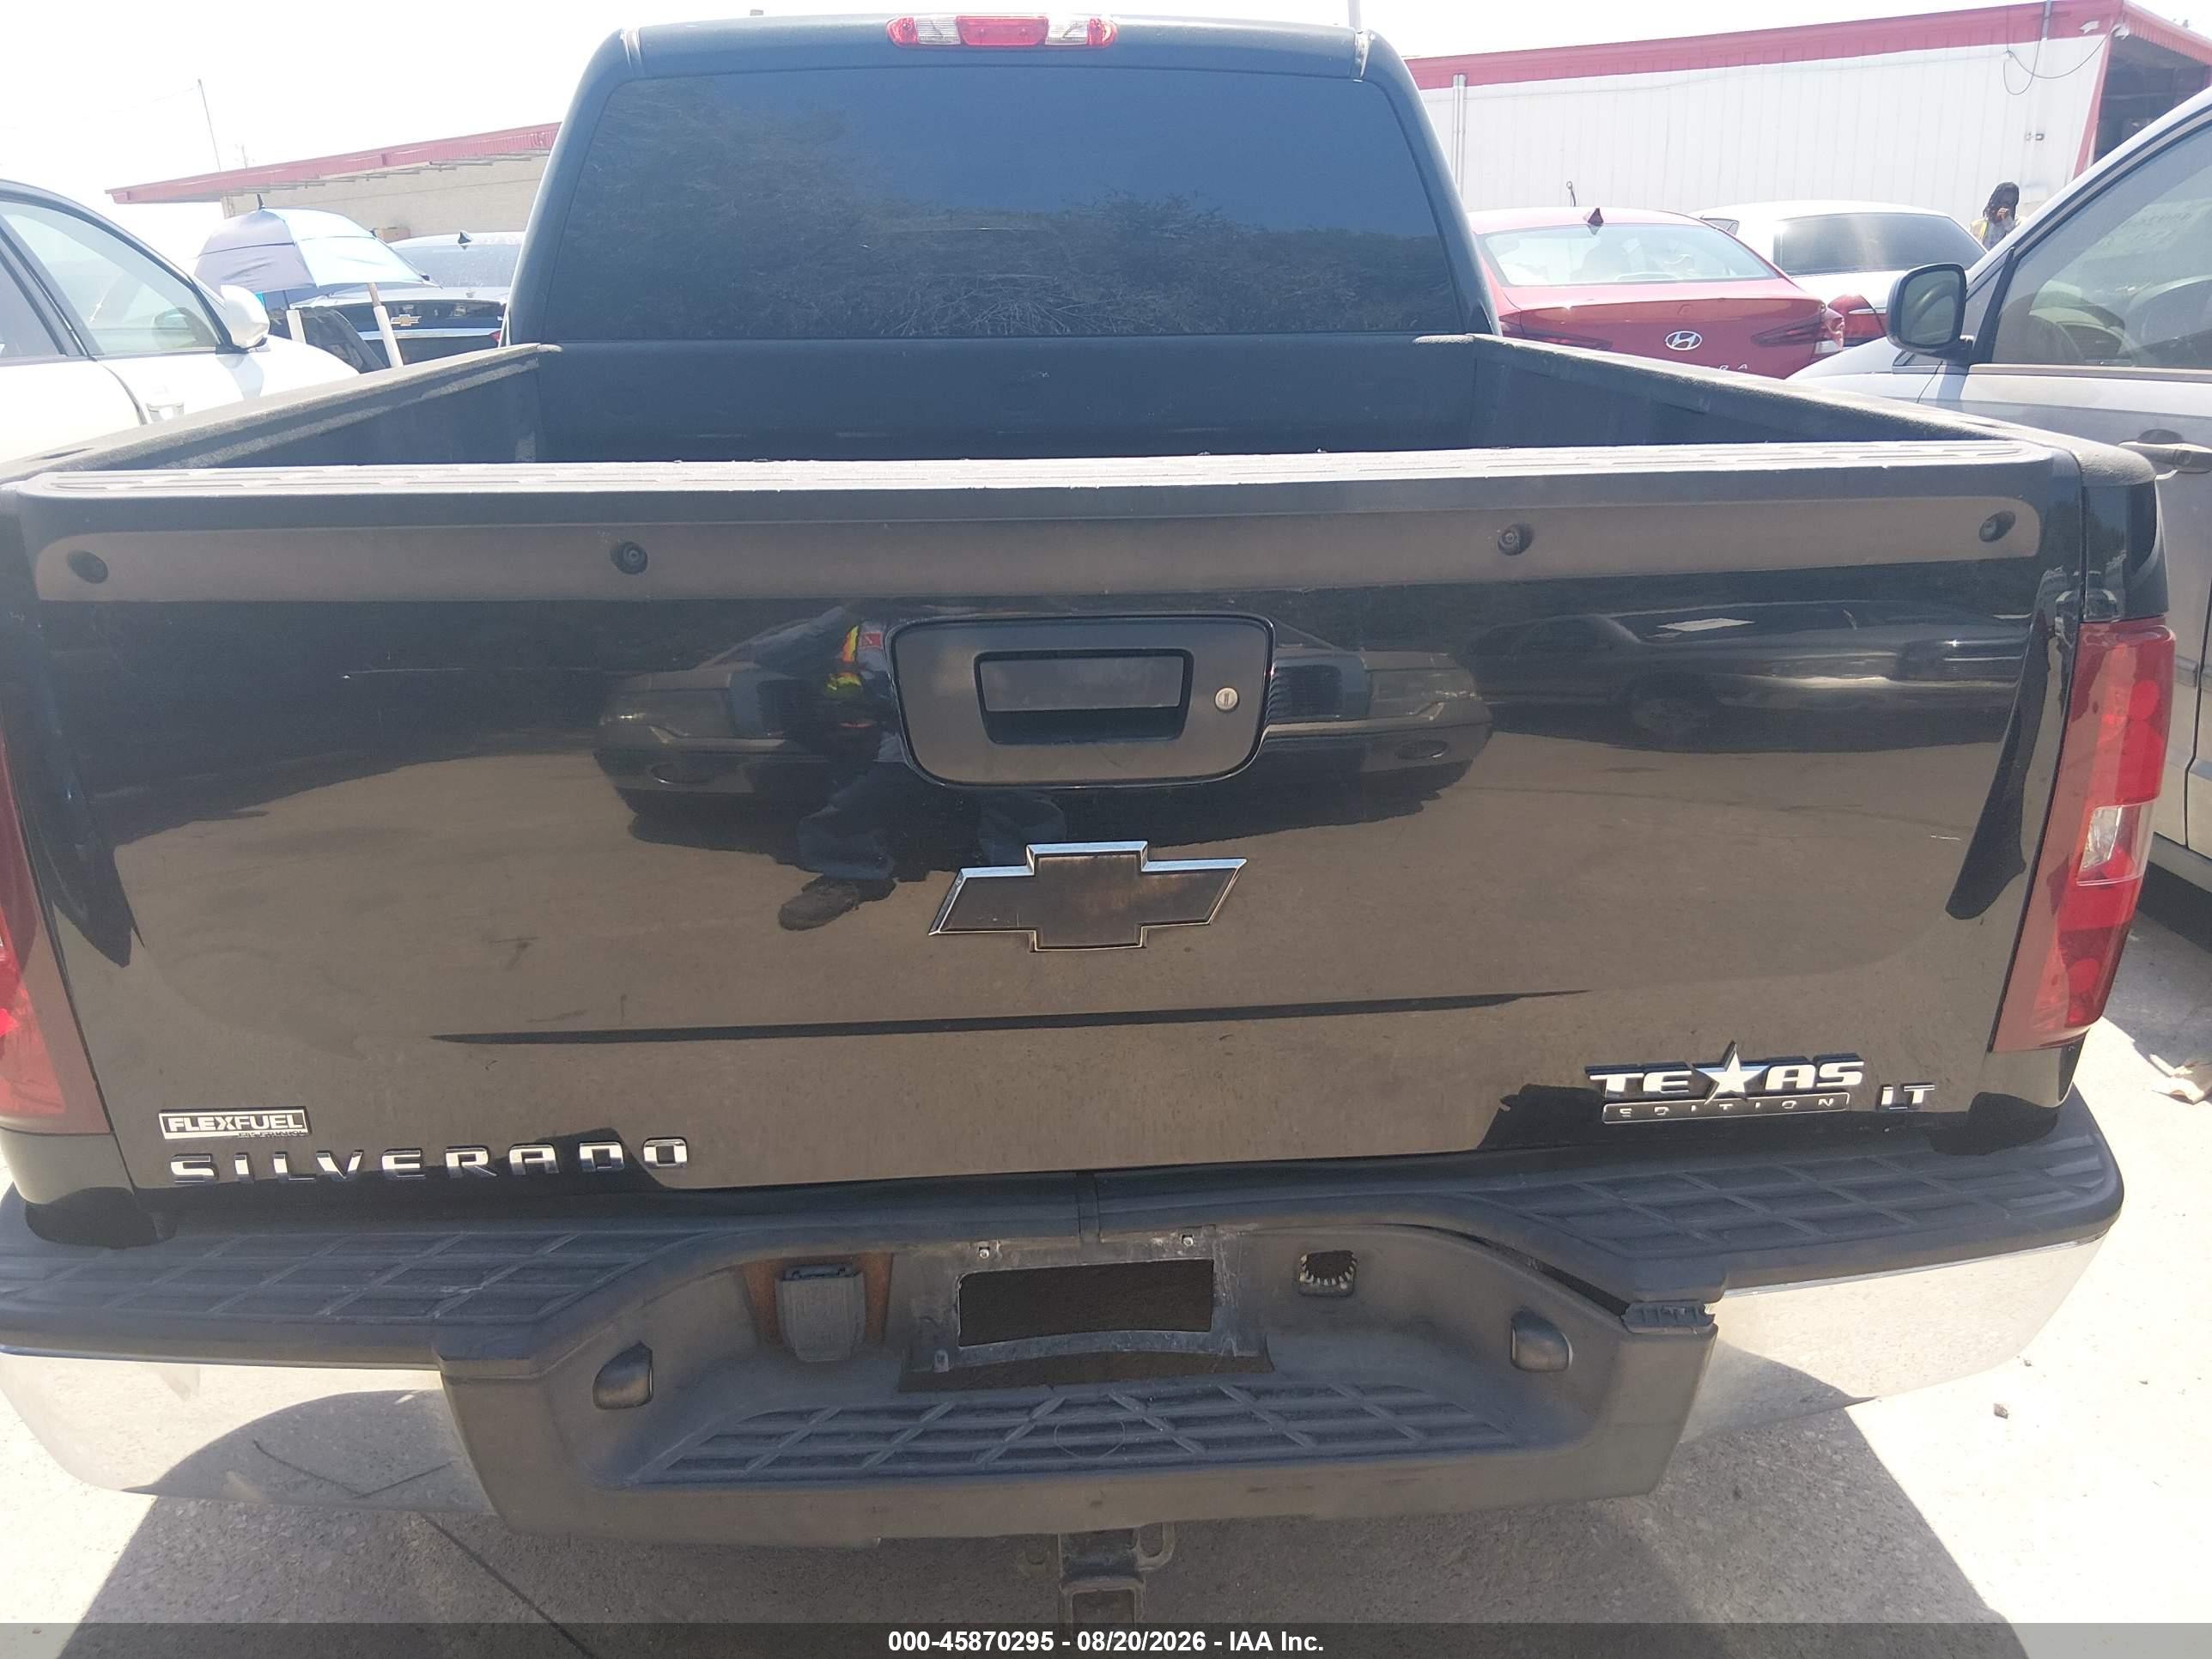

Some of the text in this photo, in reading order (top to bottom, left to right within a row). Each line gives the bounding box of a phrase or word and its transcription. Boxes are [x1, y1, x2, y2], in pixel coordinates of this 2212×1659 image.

[1619, 1097, 1835, 1118] EDITION
[1879, 1083, 1936, 1110] LT
[167, 1114, 303, 1132] FLEXFUEL
[170, 1137, 688, 1185] SILVERADO
